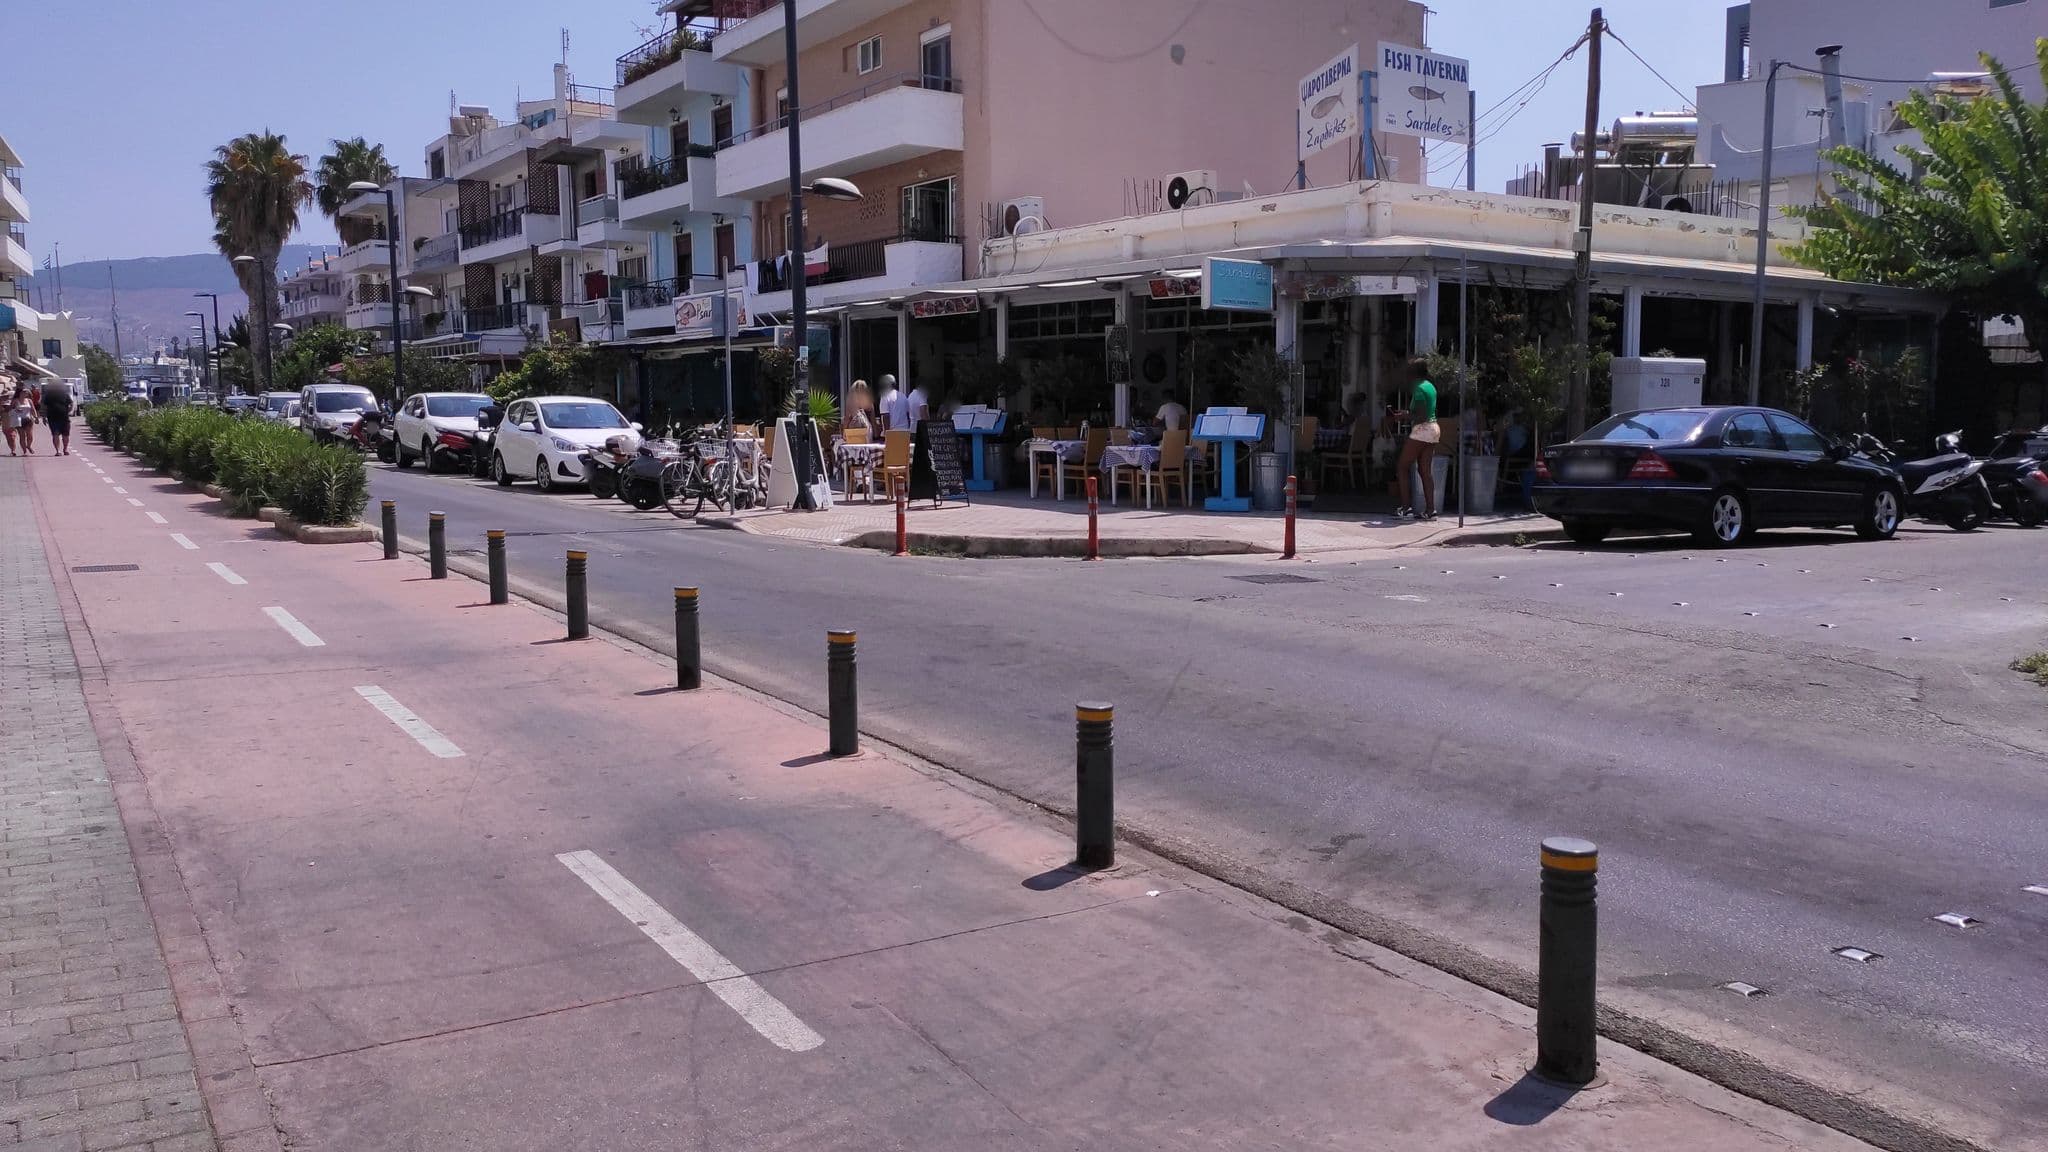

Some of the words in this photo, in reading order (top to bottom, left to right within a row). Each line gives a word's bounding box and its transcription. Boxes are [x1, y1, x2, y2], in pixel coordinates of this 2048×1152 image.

[1384, 49, 1411, 73] FISH
[1415, 54, 1467, 83] TAVERNA
[1301, 56, 1351, 107] ΨΑΡΟΤΑΒΕΡΝΑ
[1405, 110, 1452, 136] Sardeles
[697, 303, 712, 321] Psar
